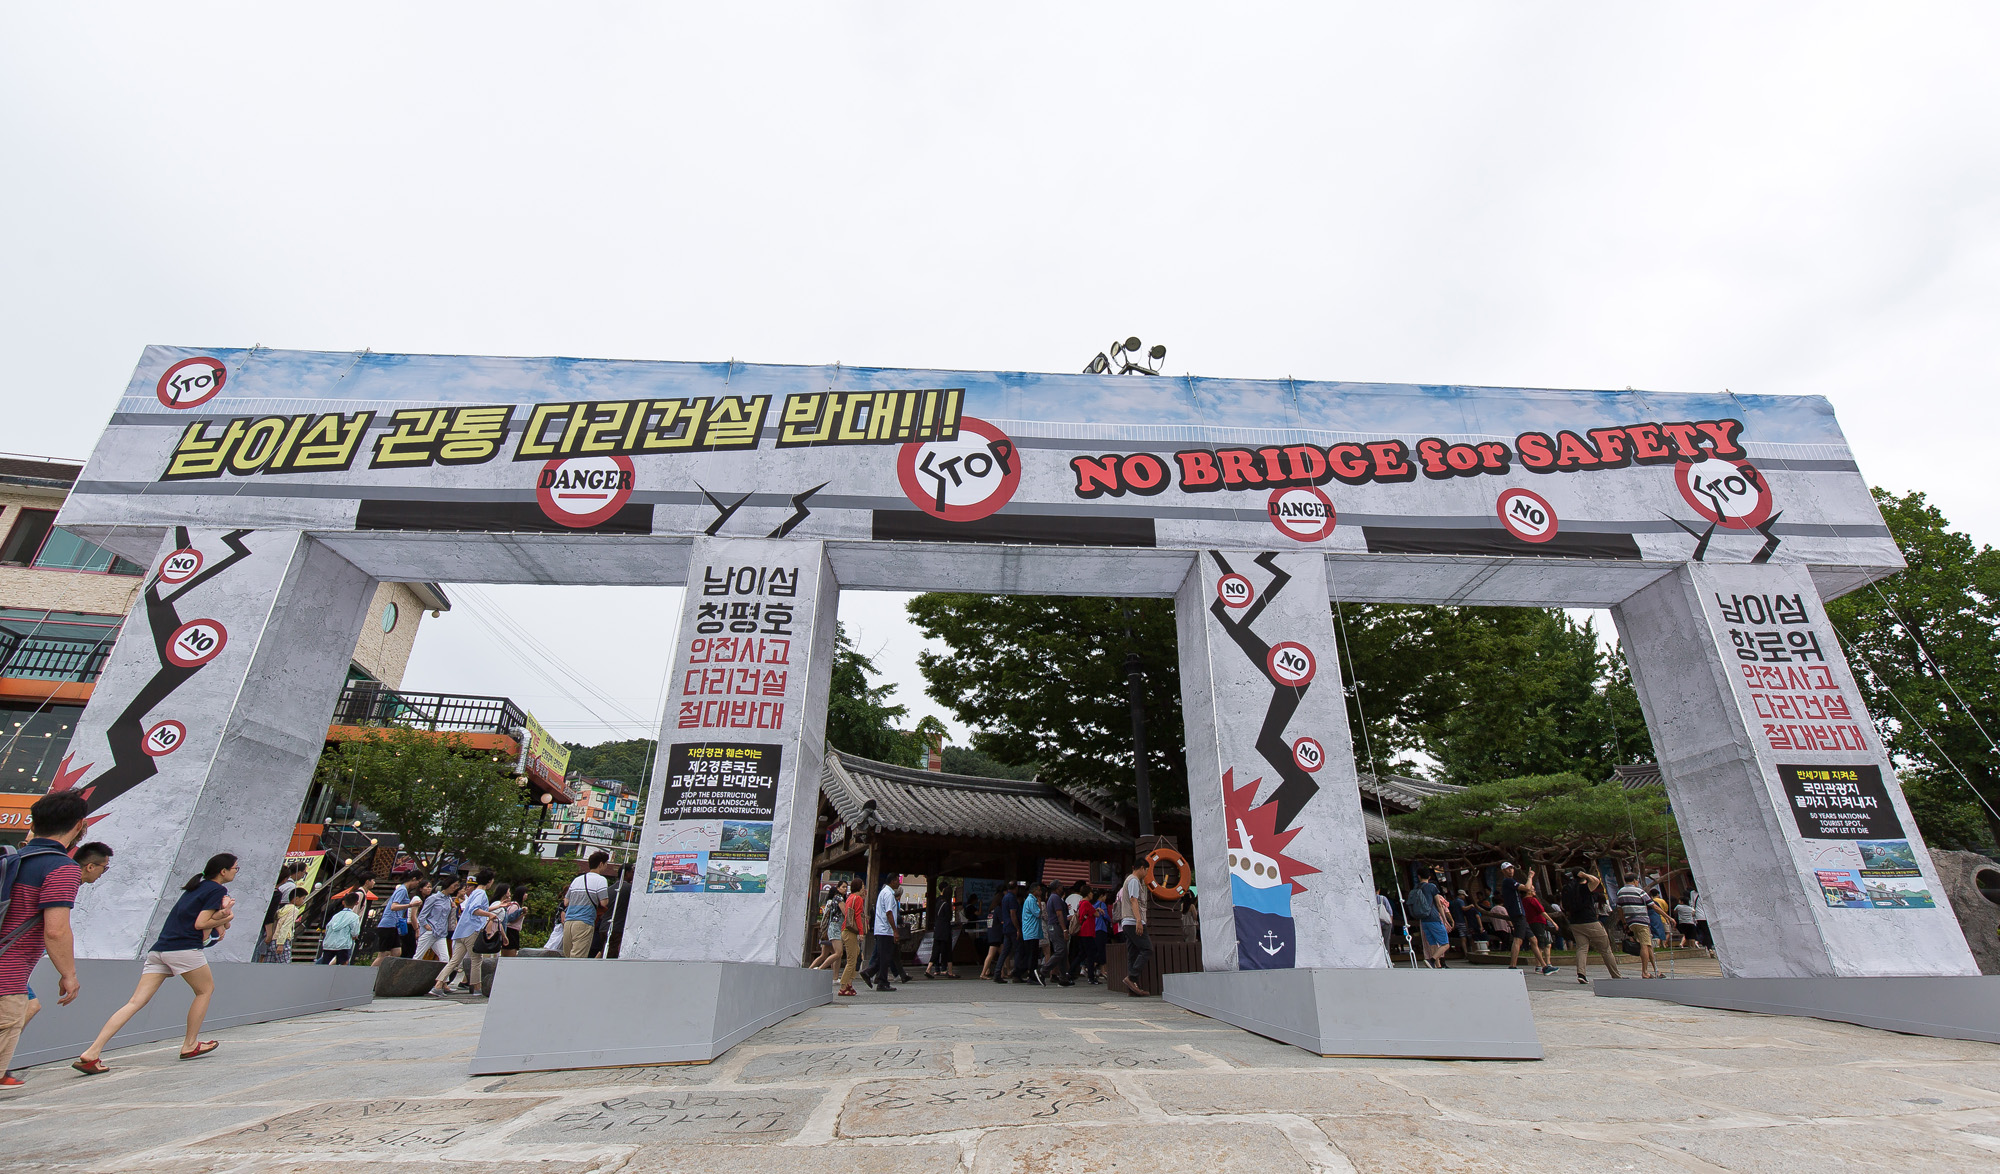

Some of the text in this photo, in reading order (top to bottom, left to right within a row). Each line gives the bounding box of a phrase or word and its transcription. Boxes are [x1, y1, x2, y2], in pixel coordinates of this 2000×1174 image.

[170, 367, 226, 406] STOP
[167, 391, 960, 475] 남이섬 관통 다리건설 반대!!!
[1074, 421, 1738, 492] NO BRIDGE for SAFETY
[538, 469, 632, 491] DANGER
[919, 438, 1012, 513] STOP
[1694, 463, 1766, 524] STOP
[1270, 500, 1335, 521] DANGER
[1511, 498, 1545, 528] NO
[170, 556, 195, 570] NO
[703, 565, 799, 597] 남이섬
[1225, 583, 1245, 596] NO
[696, 602, 793, 636] 청평호
[1715, 592, 1810, 625] 남이섬
[183, 627, 214, 652] NO
[689, 637, 790, 666] 안전사고
[1729, 628, 1825, 663] 항로위
[1280, 650, 1306, 672] NO
[683, 668, 786, 697] 다리건설
[1742, 665, 1839, 691] 안전사고
[678, 701, 784, 730] 절대반대
[1752, 693, 1853, 720] 다리건설
[153, 727, 176, 746] NO
[1763, 723, 1868, 751] 절대반대
[1300, 744, 1319, 762] NO
[688, 760, 757, 774] 제2경춘국도
[671, 774, 773, 788] 교량건설 반대한다
[1802, 782, 1860, 795] 국민관광지
[711, 791, 757, 799] DESTRUCTION
[1795, 795, 1878, 809] 끝까지 지켜내자
[663, 807, 679, 815] STOP
[718, 807, 772, 815] CONSTRUCTION
